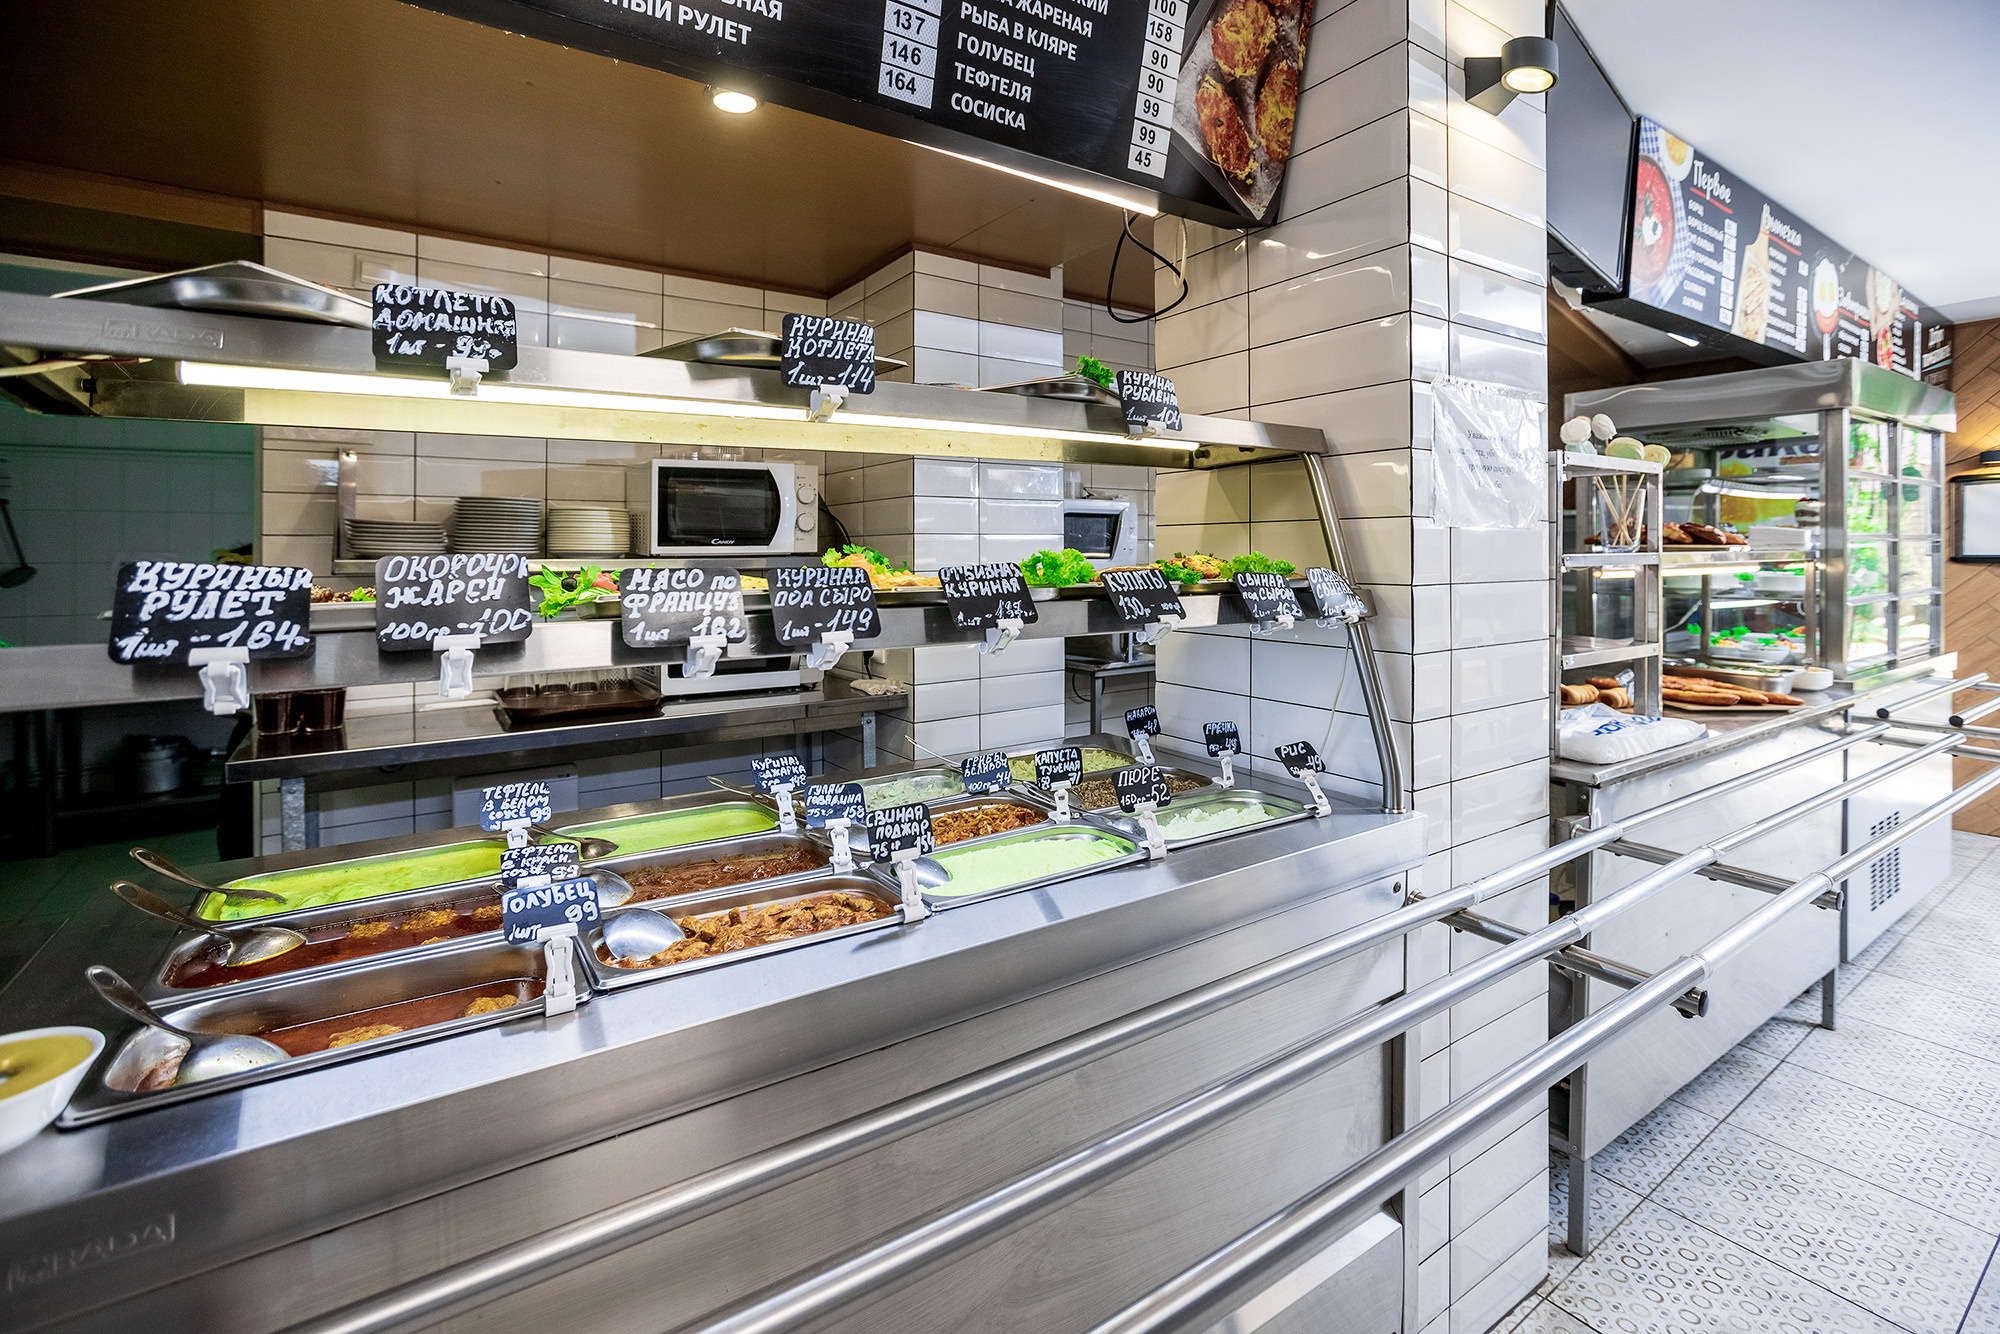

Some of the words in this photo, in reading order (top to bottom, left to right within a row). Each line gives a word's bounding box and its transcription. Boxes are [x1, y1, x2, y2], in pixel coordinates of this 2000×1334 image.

[1015, 0, 1093, 38] ЖАРЕНАЯ
[1153, 0, 1177, 17] 100
[603, 0, 672, 21] ЫЙ
[678, 4, 752, 45] РУЛЕТ
[893, 9, 925, 35] 137
[961, 2, 1010, 36] РЫБА
[1013, 22, 1025, 41] В
[1027, 27, 1078, 61] КЛЯРЕ
[1150, 20, 1173, 43] 158
[890, 41, 921, 65] 146
[957, 32, 1035, 78] ГОЛУБЕЦ
[1151, 50, 1168, 69] 90
[886, 70, 916, 95] 164
[955, 61, 1032, 103] ТЕФТЕЛЯ
[1147, 74, 1164, 93] 90
[951, 92, 1026, 131] СОСИСКА
[1143, 99, 1160, 117] 99
[1139, 126, 1156, 144] 99
[1135, 151, 1152, 168] 45
[1693, 159, 1732, 204] Первое
[789, 314, 874, 344] КУРИНАЯ
[784, 337, 876, 363] КОТЛЕТА
[1122, 370, 1176, 394] КУРИНАЯ
[127, 561, 313, 593] КУРИНЫЙ
[626, 568, 705, 592] МЯСО
[776, 567, 867, 589] КУРИНАЯ
[940, 562, 1023, 582] ОТБИВНАЯ
[1102, 569, 1168, 593] КУПАТЫ
[1237, 572, 1286, 588] СВИНАЯ
[384, 577, 506, 609] ЖАРЕН
[774, 590, 814, 609] ПОД
[820, 586, 872, 607] СЫРО
[945, 577, 1021, 598] КУРИНАЯ
[1258, 587, 1296, 602] СЫРОМ
[139, 590, 287, 621] РУЛЕТ
[623, 591, 741, 619] ФРАНЦУЗ
[692, 616, 746, 639] 162
[1034, 749, 1078, 766] КАПУСТА
[1280, 743, 1307, 758] РИС
[1118, 766, 1160, 787] ПЮРЕ
[501, 795, 549, 810] БЕЛОМ
[842, 805, 865, 819] 158
[489, 808, 527, 820] СОУСЕ
[530, 806, 552, 823] 99
[865, 805, 923, 828] СВИНАЯ
[875, 819, 930, 840] ПОДЖАР
[551, 865, 580, 879] 99
[502, 882, 595, 914] ГОЛУБЕЦ
[565, 900, 598, 922] 99
